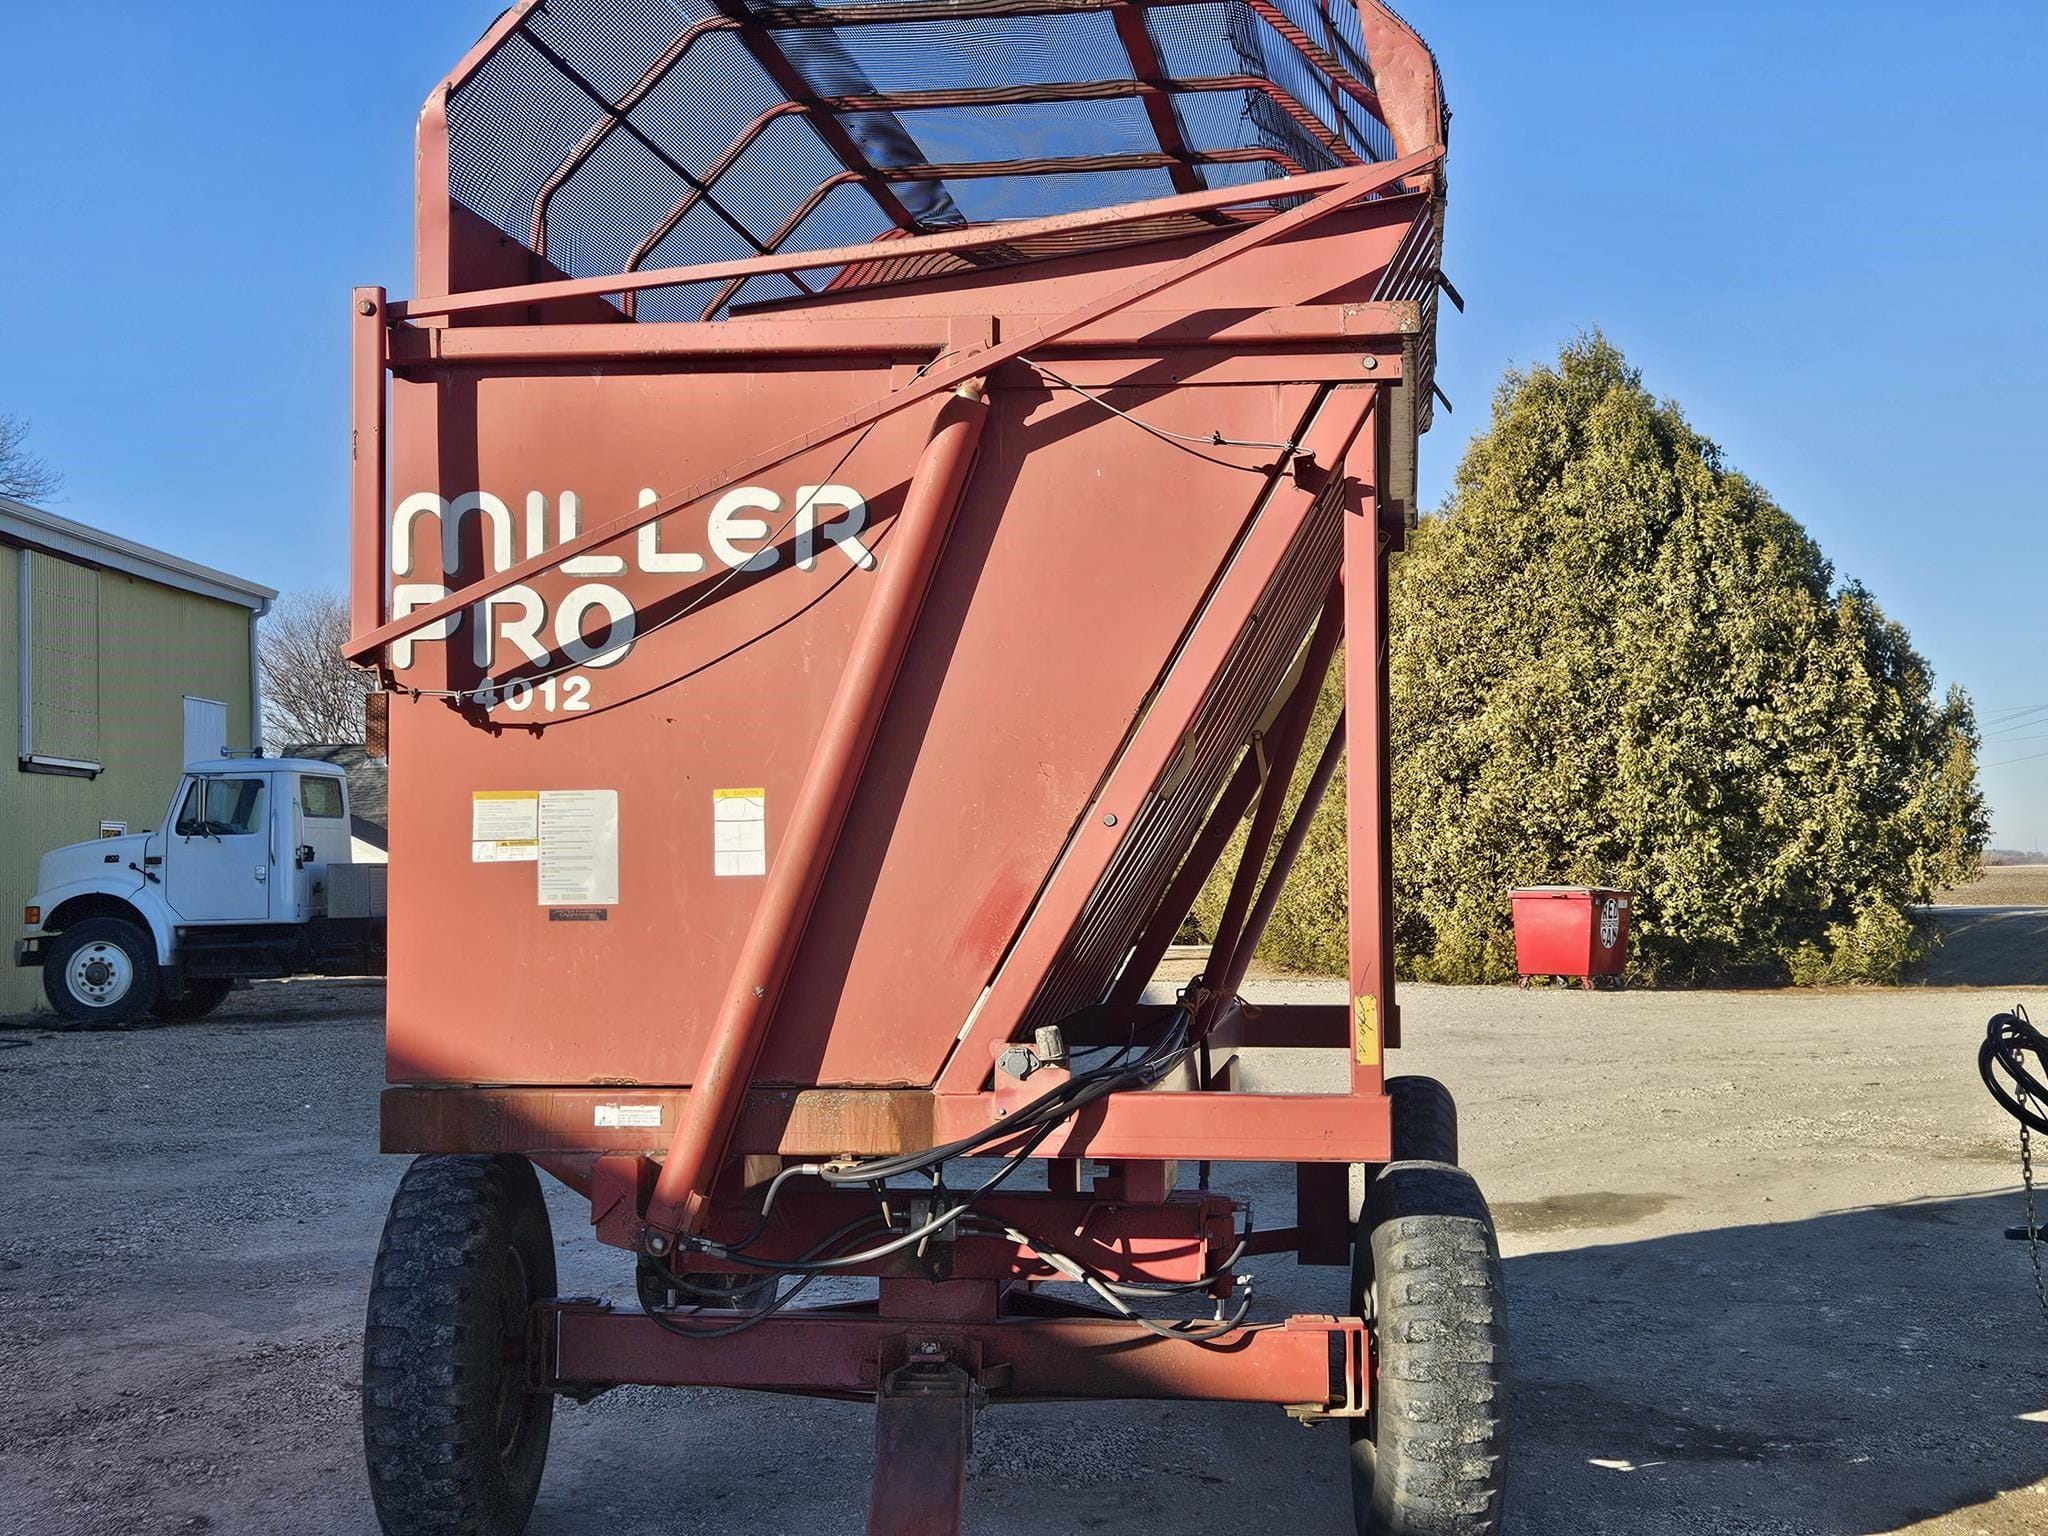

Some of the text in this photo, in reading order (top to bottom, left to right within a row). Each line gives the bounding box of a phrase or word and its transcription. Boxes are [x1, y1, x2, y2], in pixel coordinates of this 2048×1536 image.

[392, 485, 876, 577] MILLER
[392, 583, 637, 669] PRO
[473, 675, 591, 712] 4012
